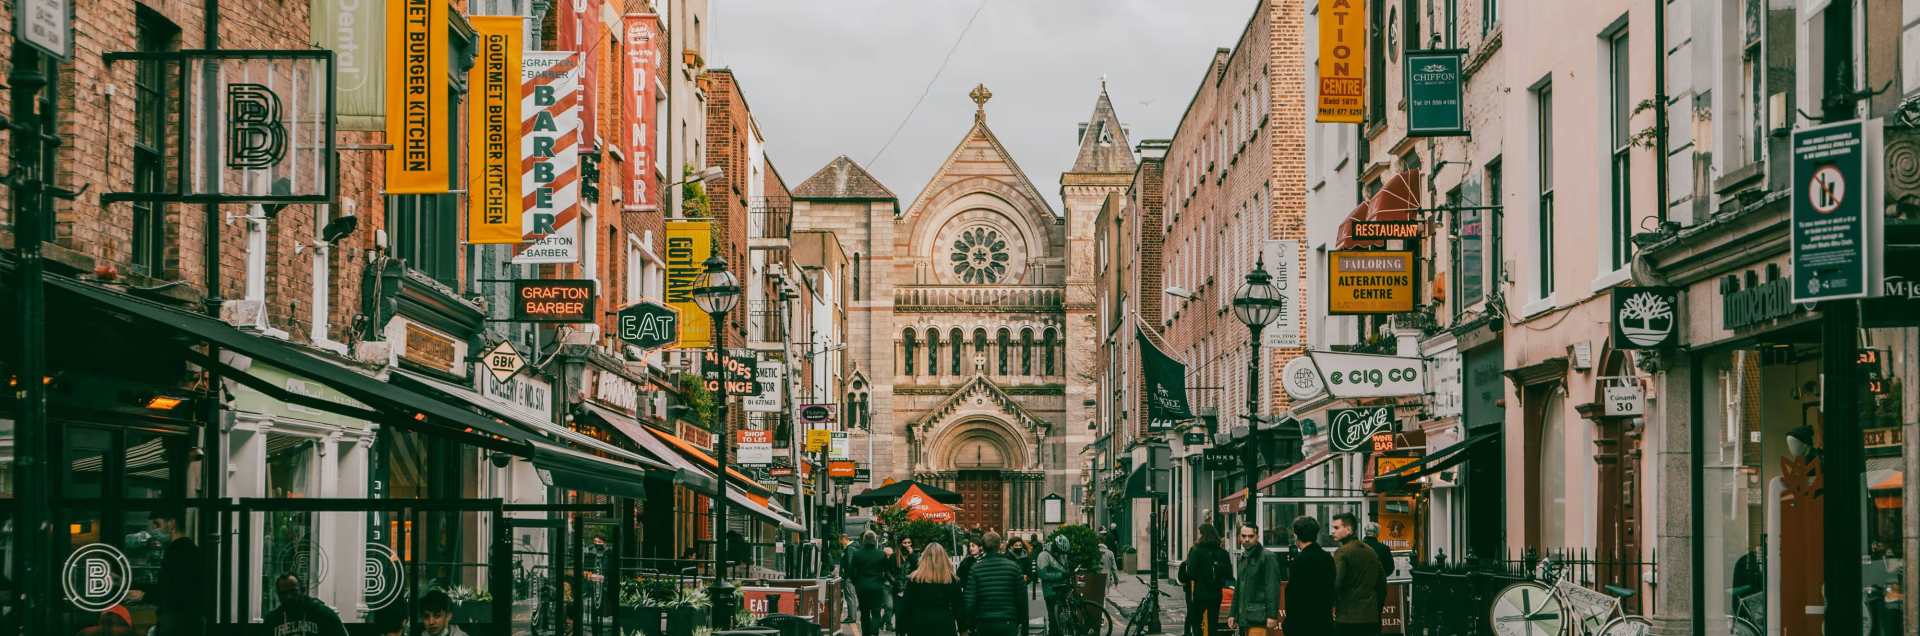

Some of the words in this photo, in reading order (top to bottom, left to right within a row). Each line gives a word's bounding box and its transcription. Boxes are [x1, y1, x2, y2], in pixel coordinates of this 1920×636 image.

[409, 32, 426, 94] BURGER
[488, 34, 504, 99] GOURMET
[527, 70, 569, 79] BARBER
[1413, 72, 1455, 81] CHIFFON
[1322, 79, 1361, 95] CENTRE
[227, 83, 289, 170] B
[488, 104, 504, 160] BURGER
[409, 100, 426, 172] KITCHEN
[632, 68, 647, 204] DINER
[533, 85, 558, 235] BARBER
[488, 163, 503, 225] KITCHEN
[1356, 223, 1418, 237] RESTAURANT
[527, 249, 568, 257] BARBER
[668, 237, 694, 303] GOTHAM
[1343, 259, 1401, 269] TAILORING
[1277, 261, 1288, 291] Clinic
[1338, 275, 1408, 286] ALTERATIONS
[521, 287, 589, 300] GRAFTON
[1353, 288, 1393, 300] CENTRE
[526, 302, 584, 315] BARBER
[622, 316, 673, 340] EAT
[728, 349, 756, 358] WINES
[493, 355, 515, 368] GBK
[1330, 371, 1343, 385] e
[1348, 368, 1383, 388] cig
[1388, 367, 1417, 383] co
[1616, 402, 1633, 412] 30
[1331, 408, 1393, 451] Cave
[1372, 434, 1393, 442] WINE
[1374, 441, 1393, 451] BAR
[85, 558, 113, 597] B
[750, 599, 769, 612] EAT
